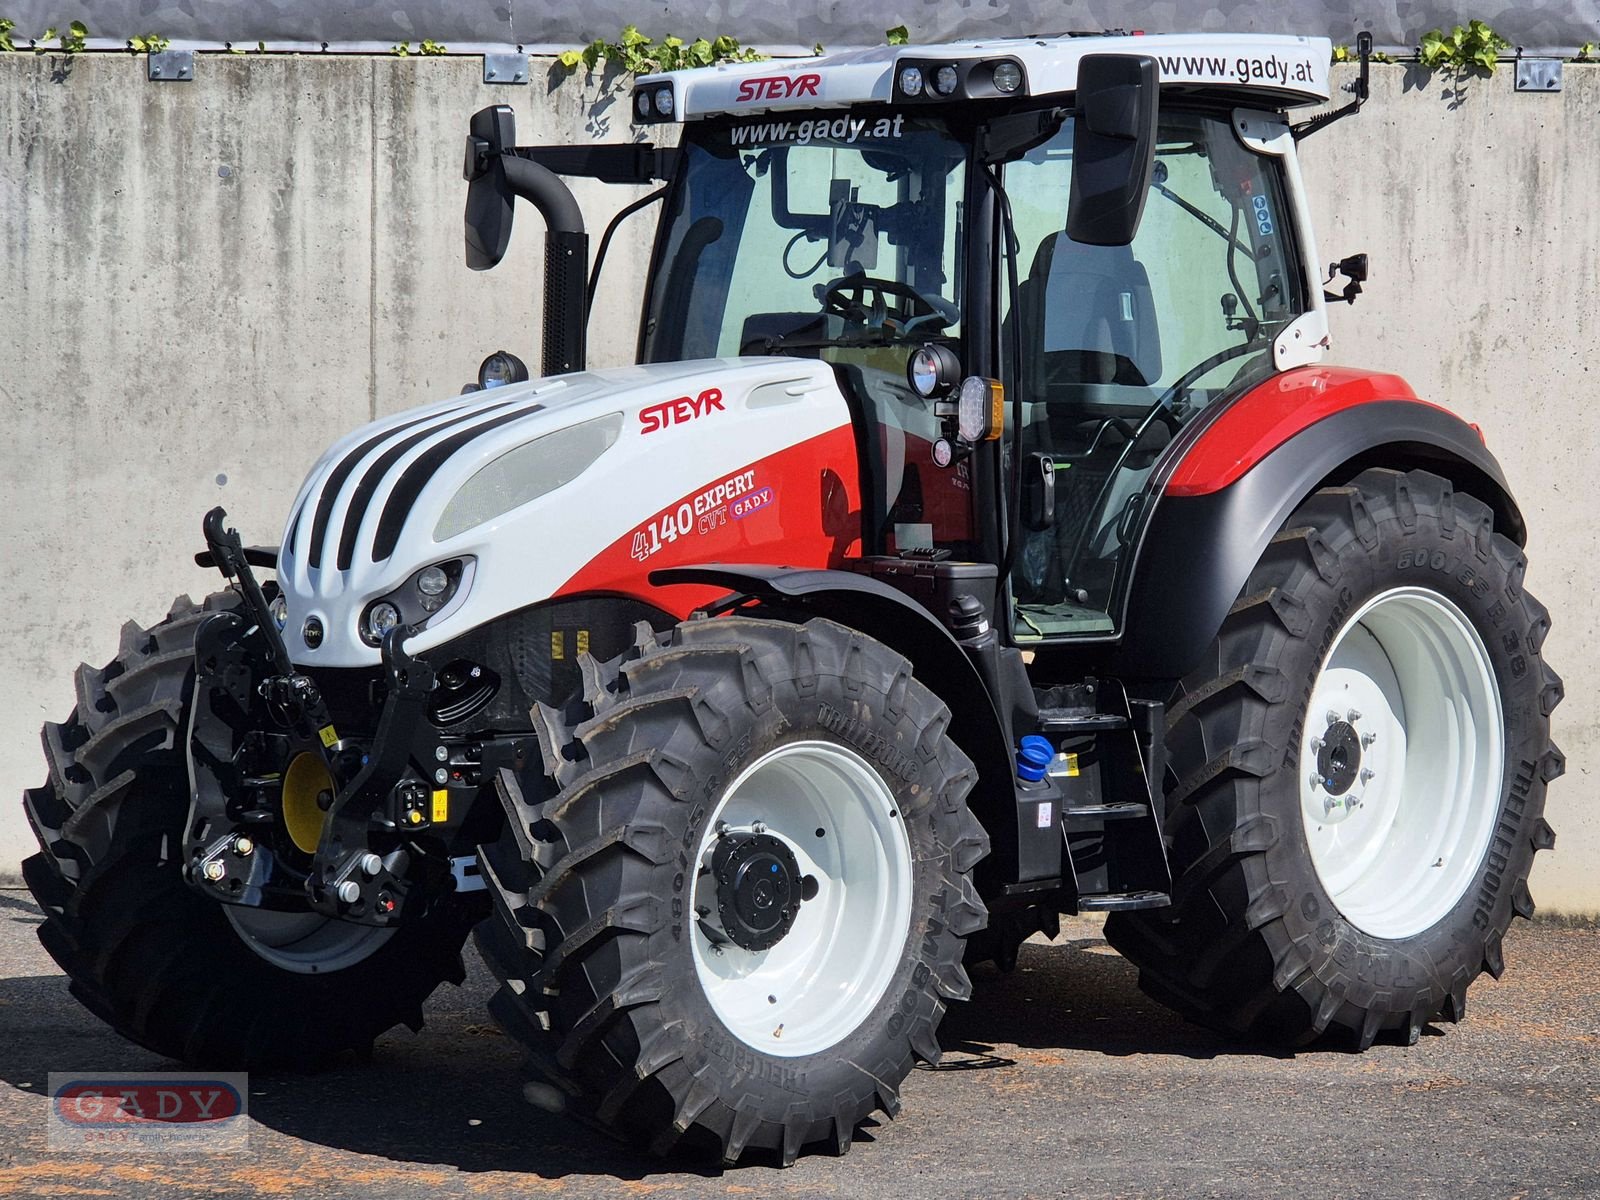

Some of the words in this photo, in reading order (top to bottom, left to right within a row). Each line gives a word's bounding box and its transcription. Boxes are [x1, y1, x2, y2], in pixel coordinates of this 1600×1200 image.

[736, 74, 821, 102] STEYR
[1158, 55, 1314, 84] www.gady.at
[731, 114, 904, 145] www.gady.at
[639, 387, 726, 435] STEYR
[630, 503, 693, 562] 4140
[695, 470, 755, 515] EXPERT
[698, 505, 728, 535] CVT
[734, 491, 769, 515] GADY
[1502, 630, 1527, 680] 38
[816, 700, 920, 783] TRELLEBORG
[1472, 759, 1538, 932] TRELLEBORG
